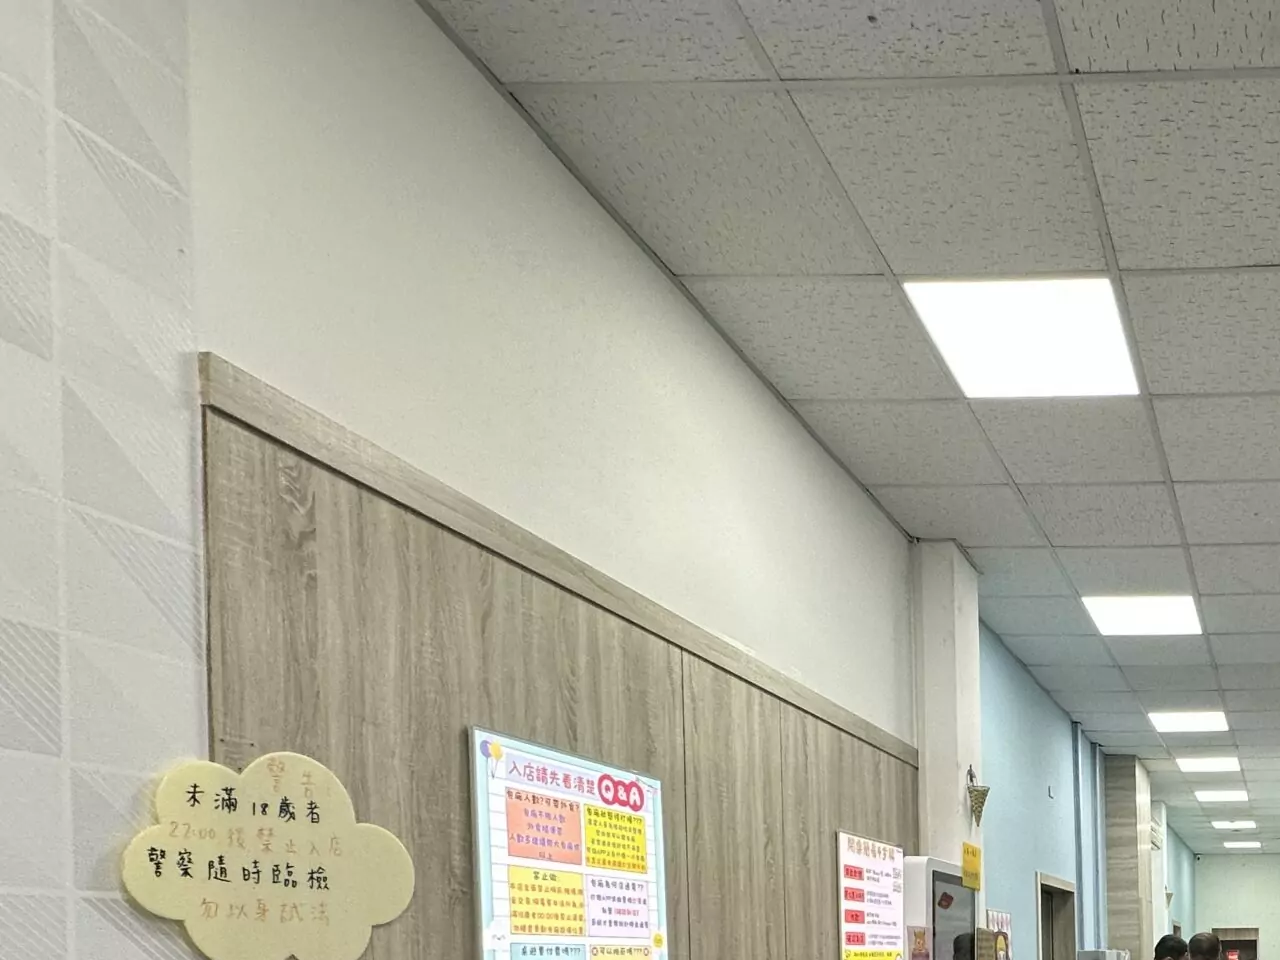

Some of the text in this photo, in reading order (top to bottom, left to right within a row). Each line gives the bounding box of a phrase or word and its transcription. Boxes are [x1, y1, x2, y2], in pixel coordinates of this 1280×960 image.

[508, 760, 643, 808] 入店請先看清楚 Q&A
[147, 847, 330, 890] 警察隨時臨檢
